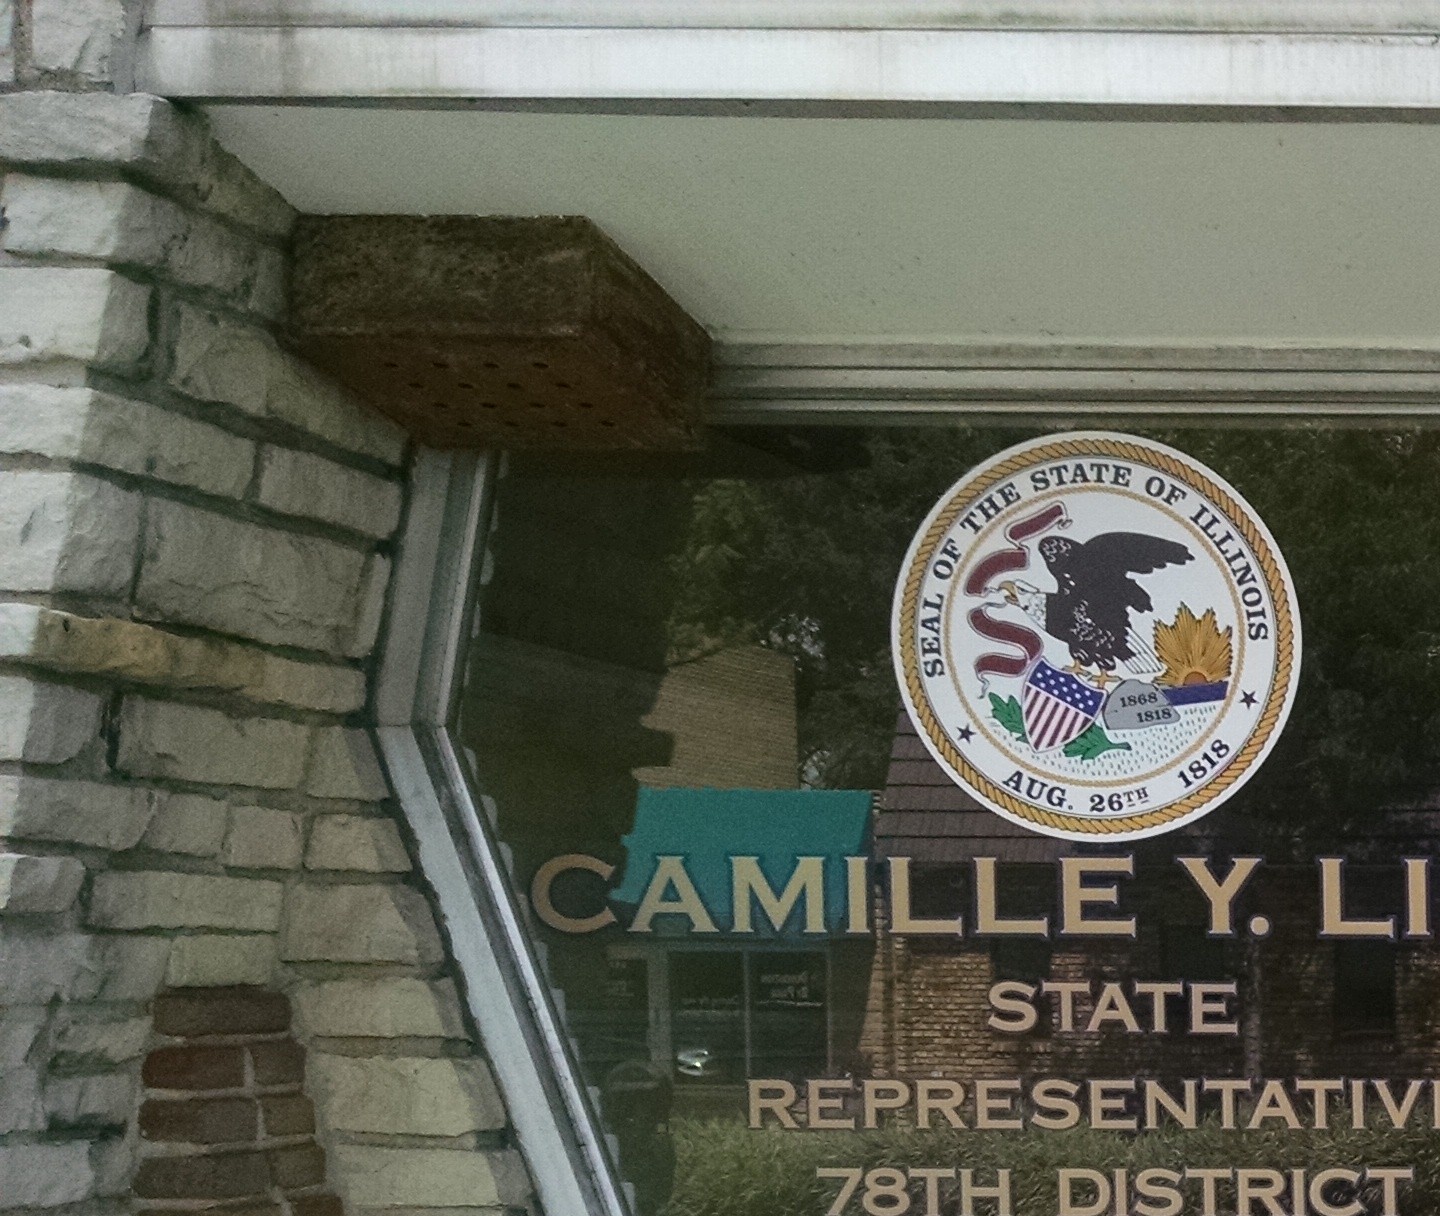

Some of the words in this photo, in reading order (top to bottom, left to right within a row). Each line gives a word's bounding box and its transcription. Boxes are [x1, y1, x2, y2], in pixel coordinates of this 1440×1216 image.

[1030, 463, 1132, 491] STATE
[1145, 476, 1187, 505] OF
[960, 482, 1021, 534] THE
[934, 539, 962, 578] OF
[1189, 505, 1269, 641] ILLINOIS
[924, 593, 945, 678] SEAL
[1120, 692, 1158, 707] 1868
[1137, 708, 1172, 722] 1818
[1002, 770, 1074, 811] AUG.
[1089, 787, 1149, 812] 26TH
[1177, 739, 1231, 788] 1818
[531, 853, 1137, 936] CAMILLE
[1177, 857, 1270, 936] Y.
[988, 981, 1239, 1034] STATE
